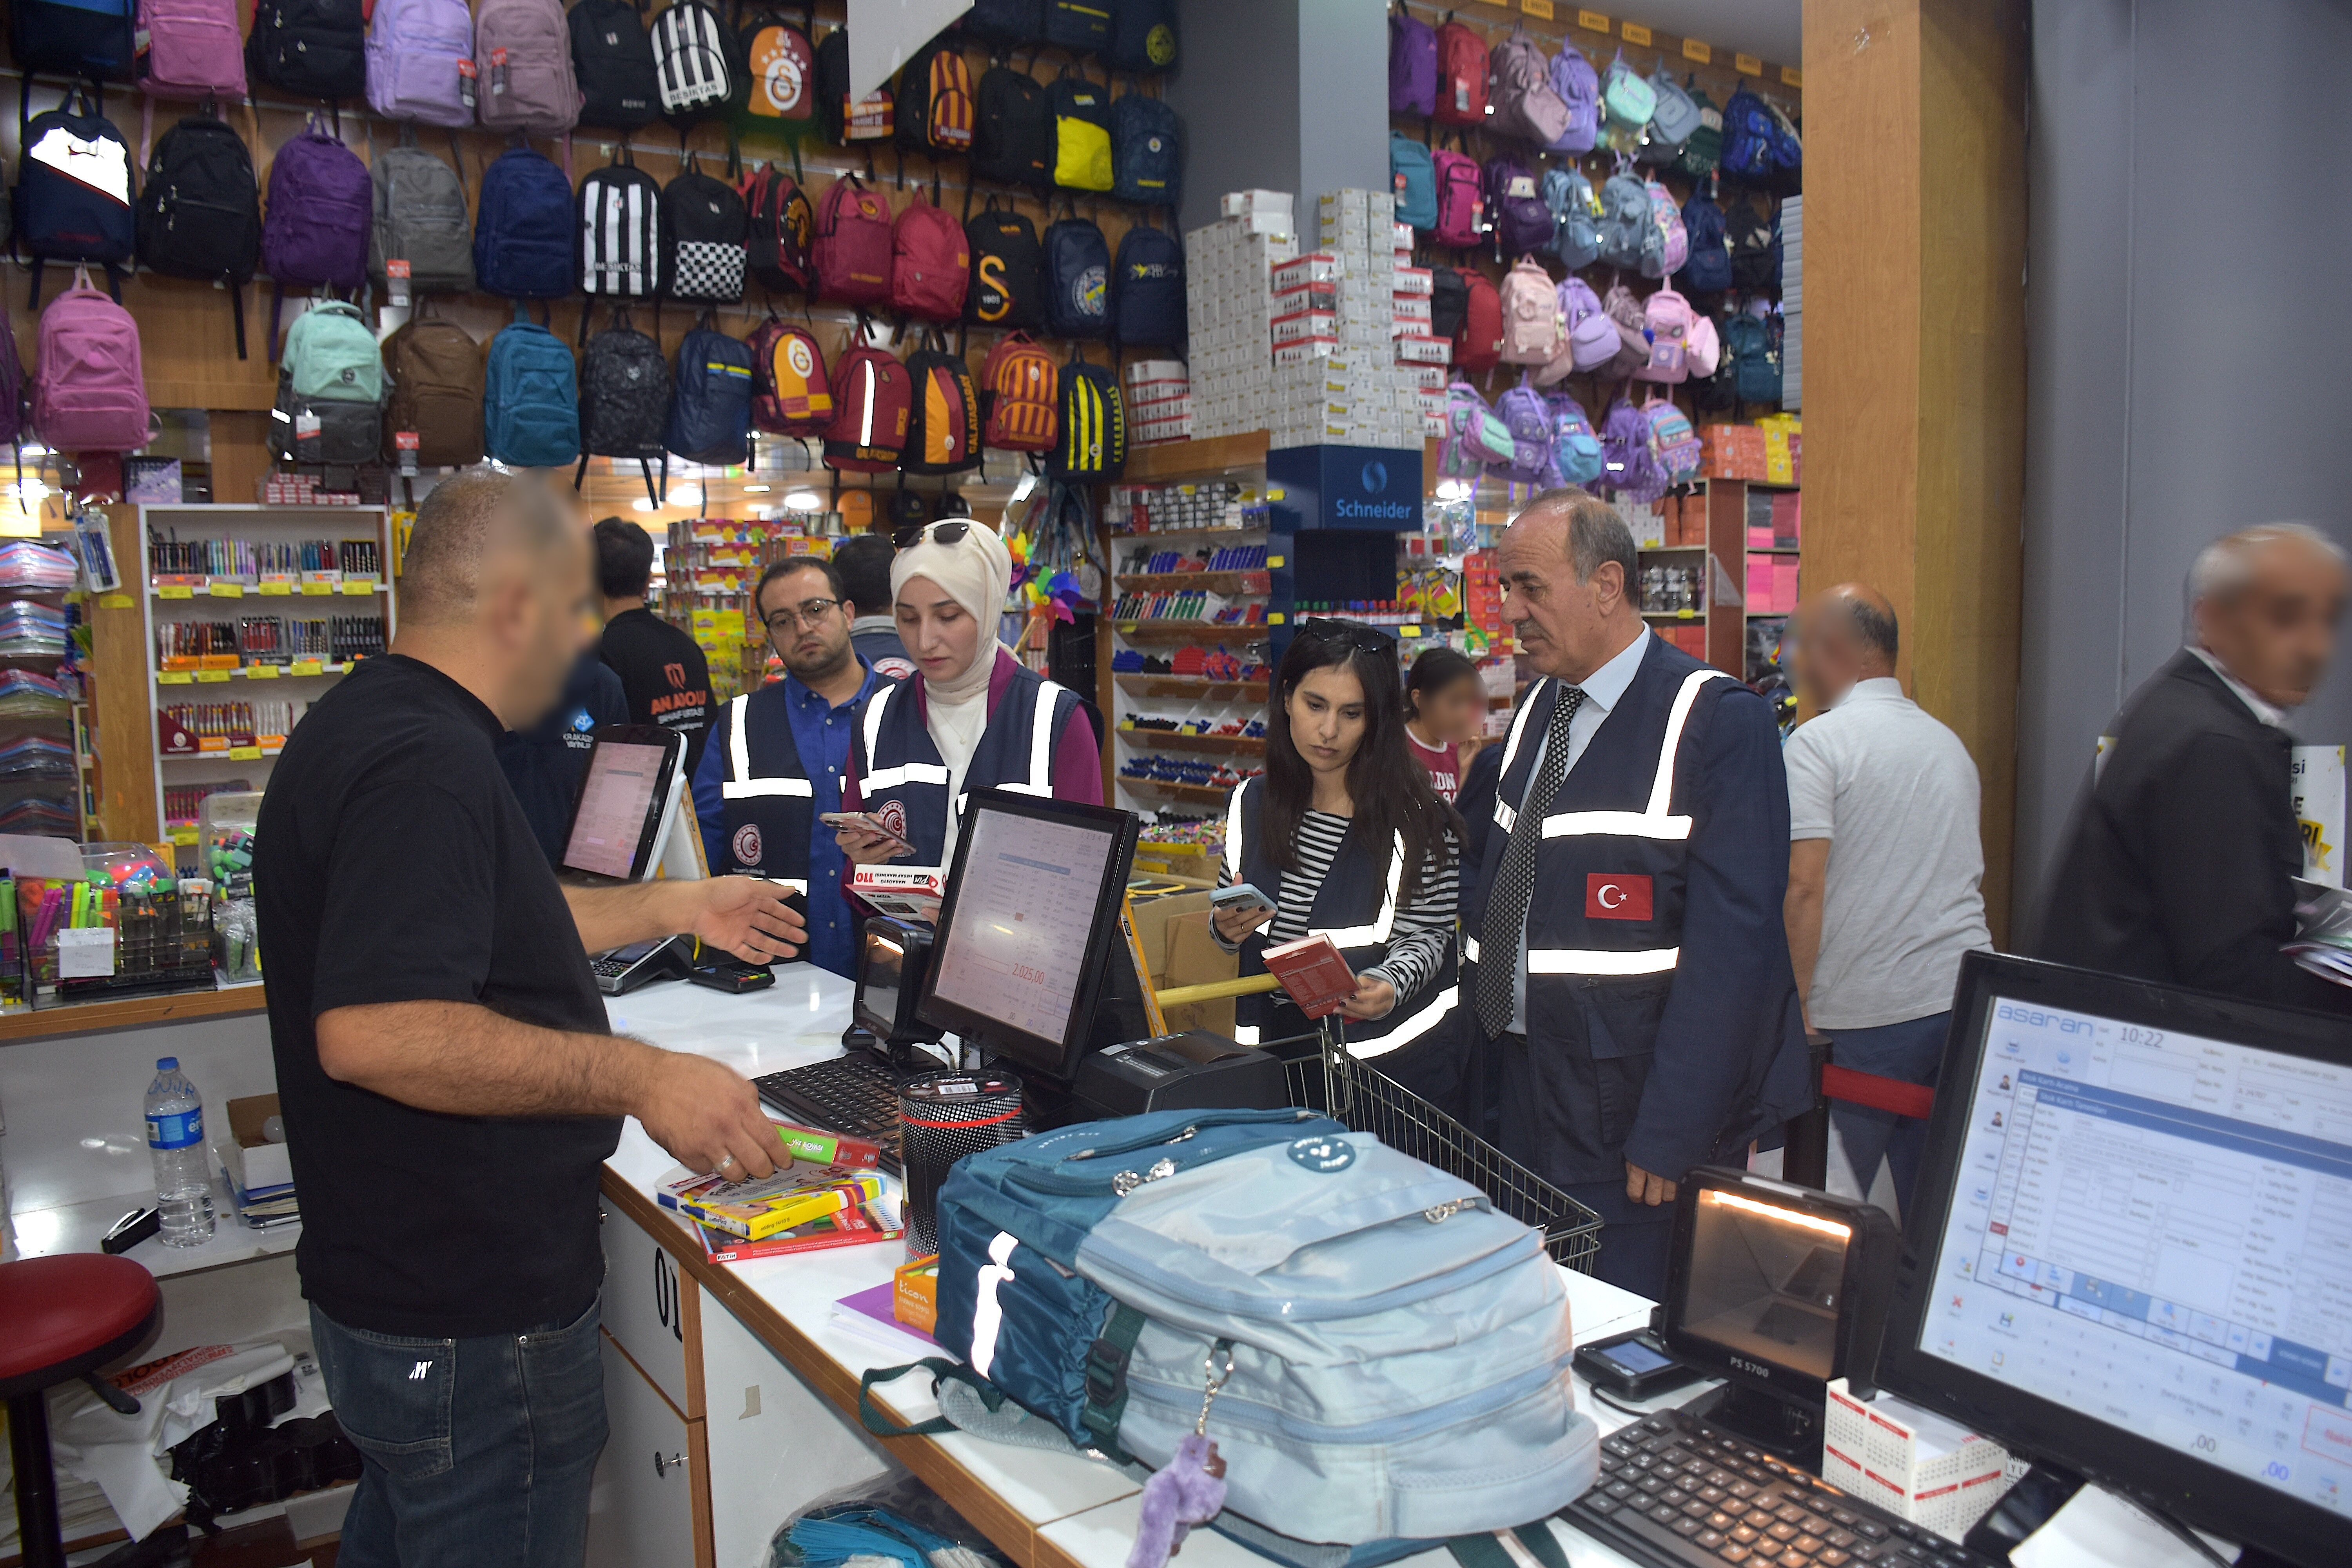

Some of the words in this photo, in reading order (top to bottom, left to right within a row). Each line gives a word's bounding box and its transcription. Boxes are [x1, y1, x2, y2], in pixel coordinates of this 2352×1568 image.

[1336, 498, 1411, 519] Schneider
[856, 873, 873, 883] 110
[1012, 963, 1045, 985] 2.025,00
[1999, 1005, 2094, 1037] asaran
[2120, 1026, 2164, 1048] 10:22
[760, 1223, 775, 1231] edding
[775, 1219, 786, 1227] 14/10
[899, 1279, 929, 1304] ticon
[1730, 1357, 1742, 1368] PS
[1744, 1361, 1769, 1378] 5700
